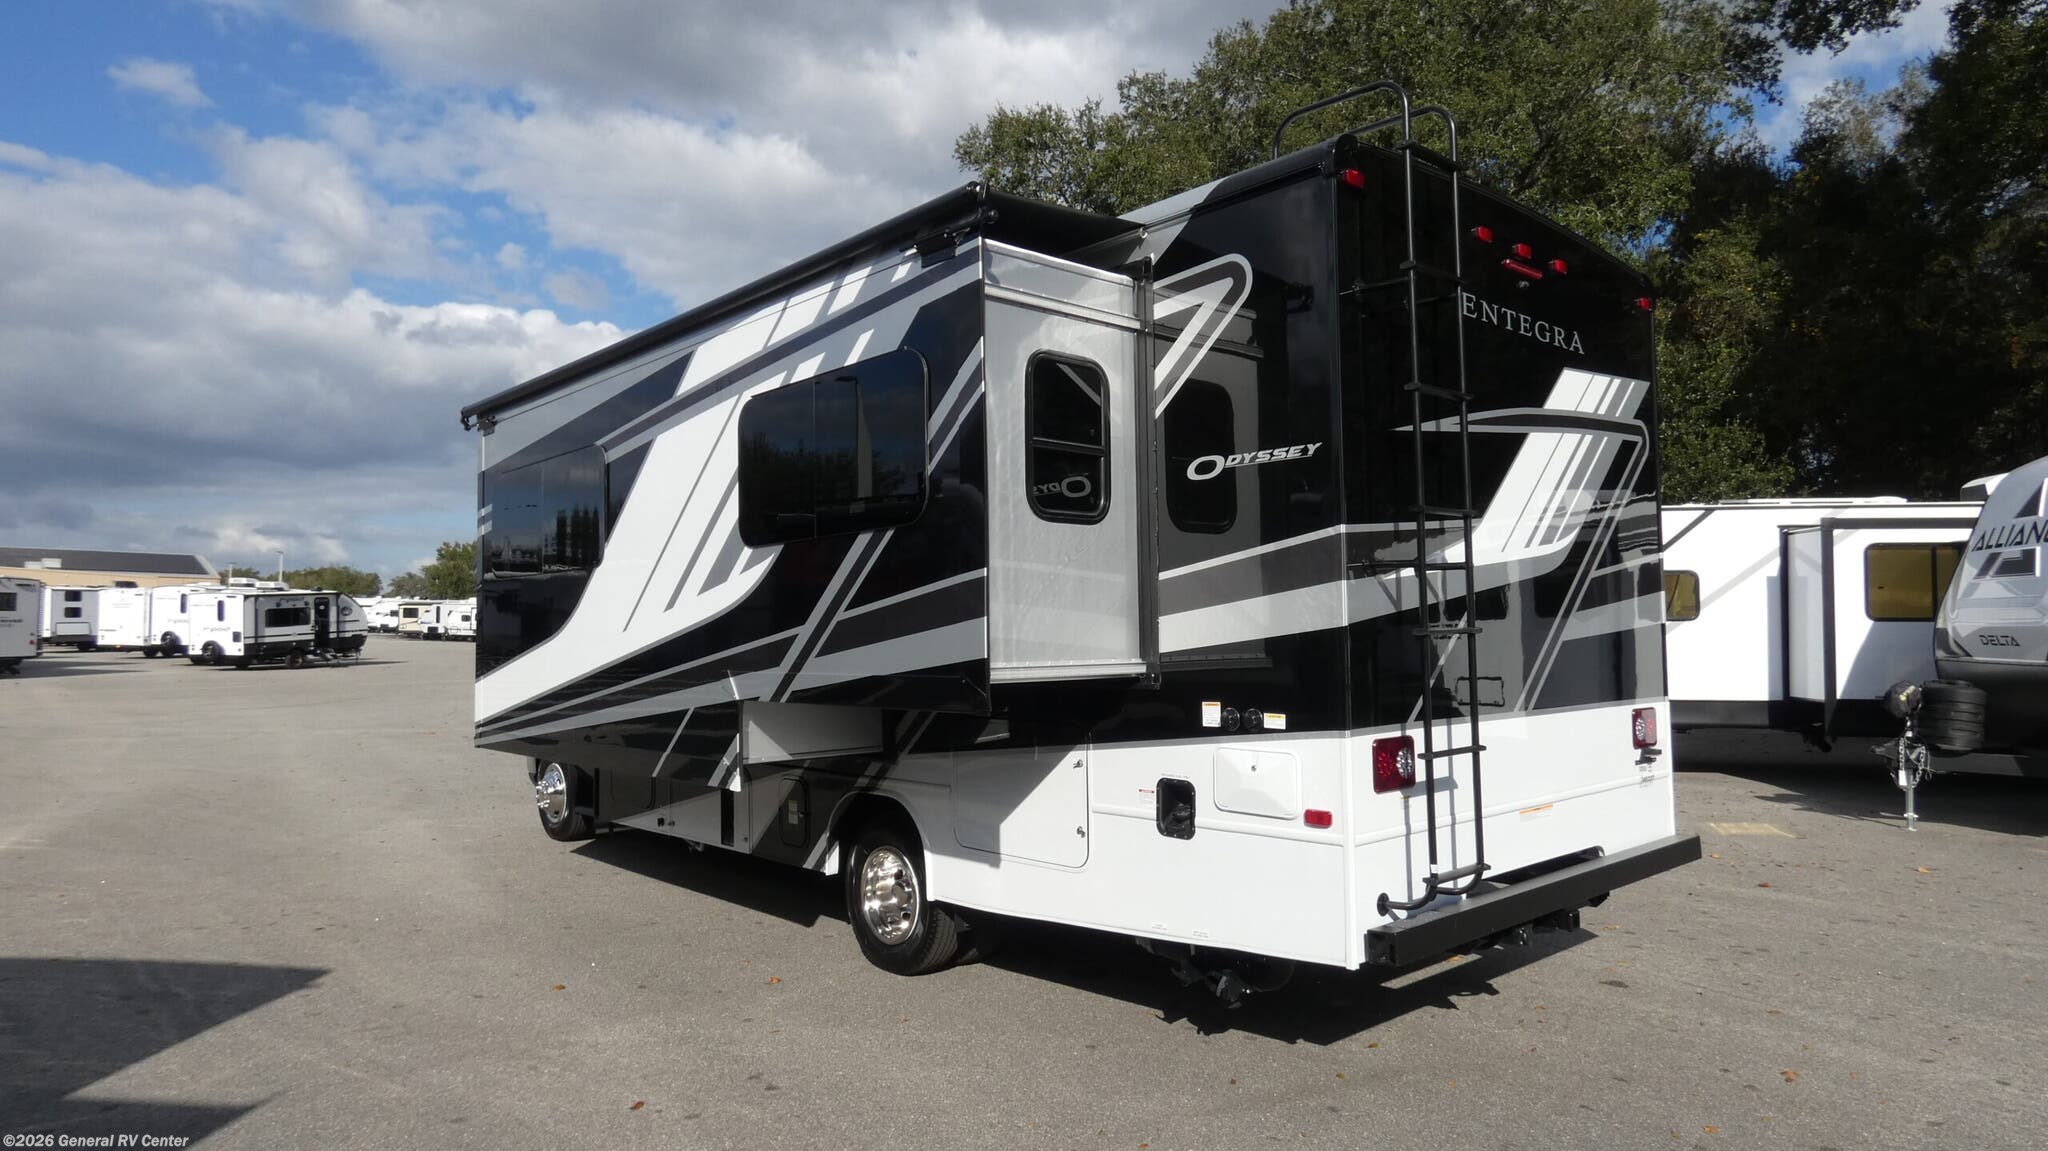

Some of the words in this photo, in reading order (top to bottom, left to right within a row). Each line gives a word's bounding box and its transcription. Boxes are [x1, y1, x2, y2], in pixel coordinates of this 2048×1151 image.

[1461, 292, 1585, 355] ENTEGRA
[1186, 442, 1323, 481] ODYSSEY
[1978, 634, 2021, 647] DELTA
